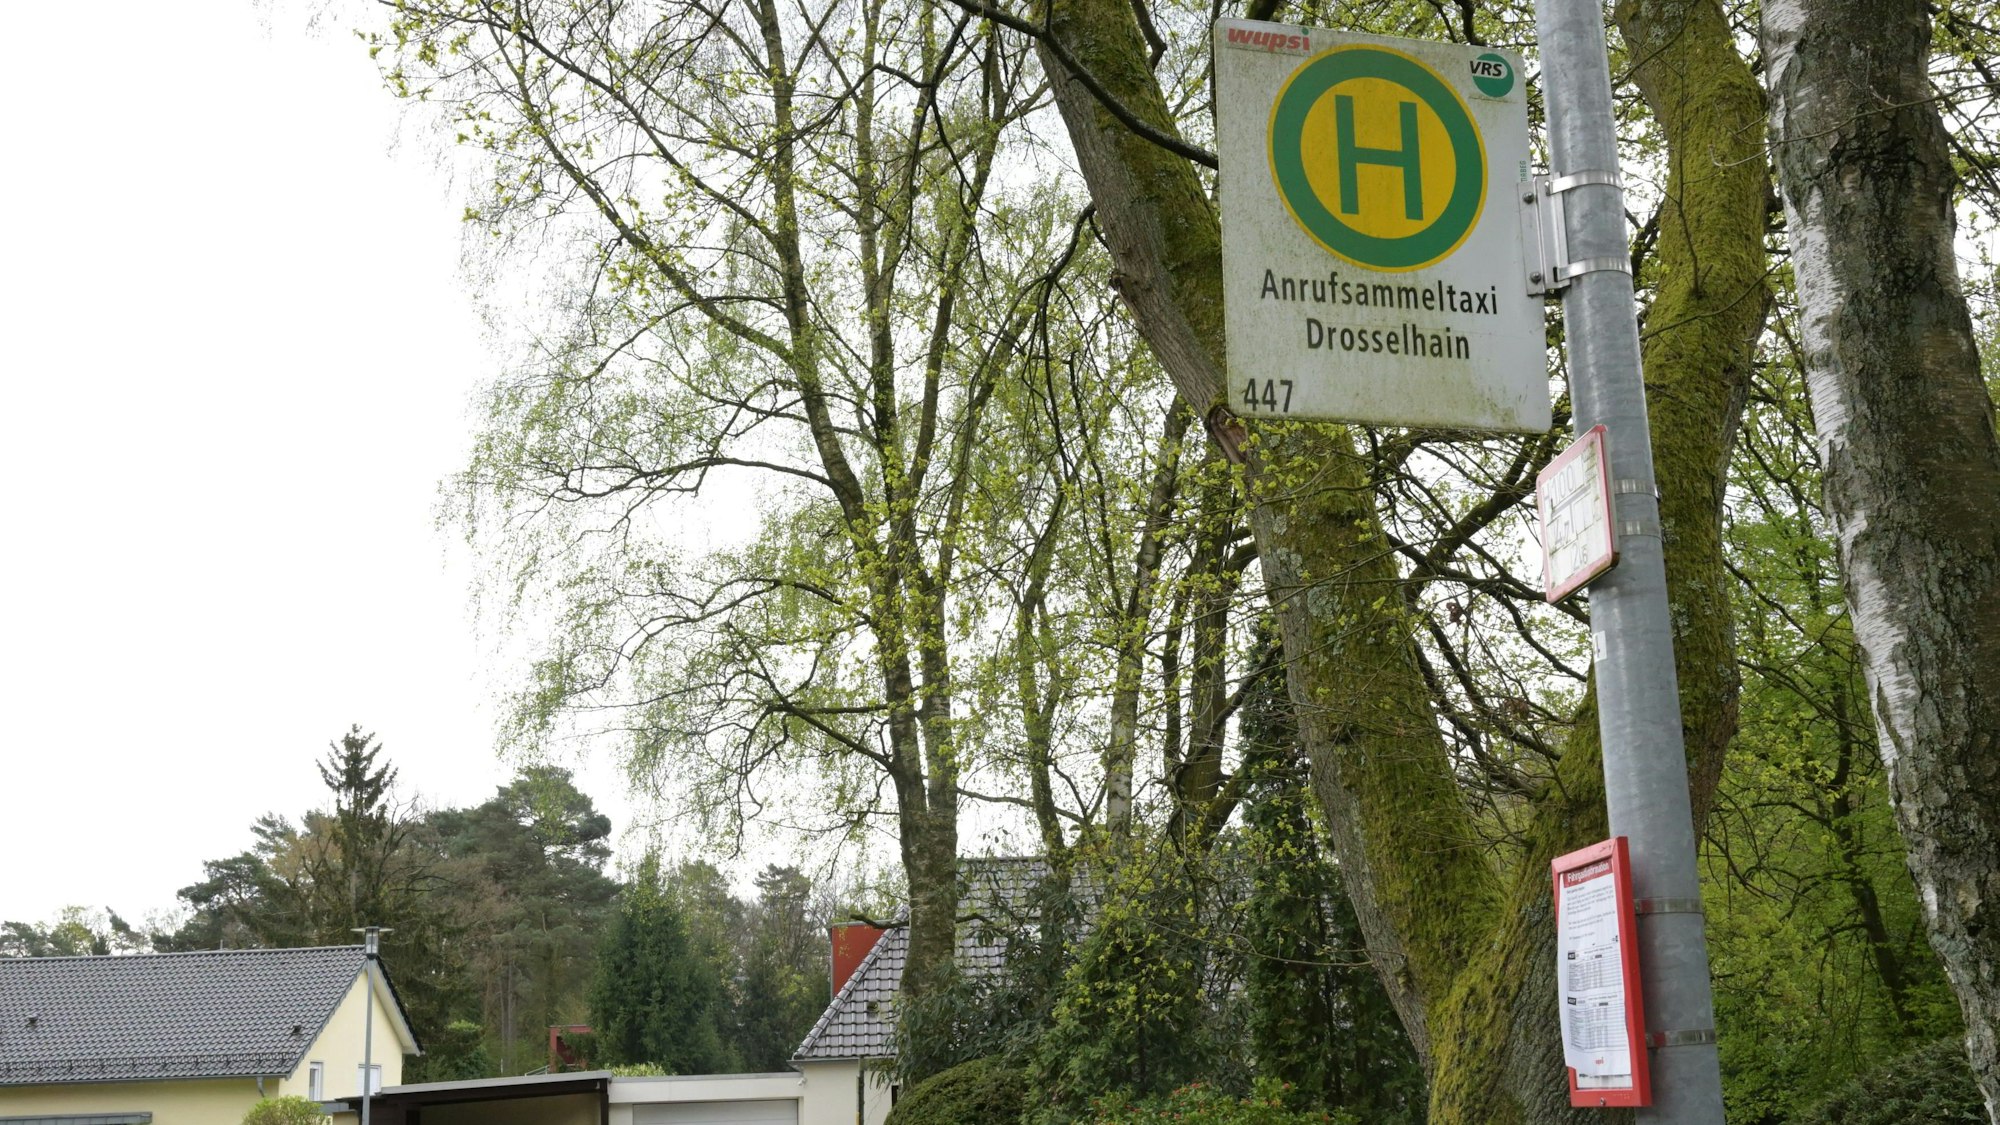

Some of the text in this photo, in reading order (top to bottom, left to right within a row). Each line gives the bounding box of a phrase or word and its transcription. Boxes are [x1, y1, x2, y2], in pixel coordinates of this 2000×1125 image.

[1227, 28, 1310, 51] wupsi
[1470, 60, 1503, 77] VRS
[1335, 94, 1423, 221] H
[1261, 268, 1498, 315] Anrufsammeltaxi
[1306, 318, 1470, 360] Drosselhain
[1243, 378, 1293, 412] 447
